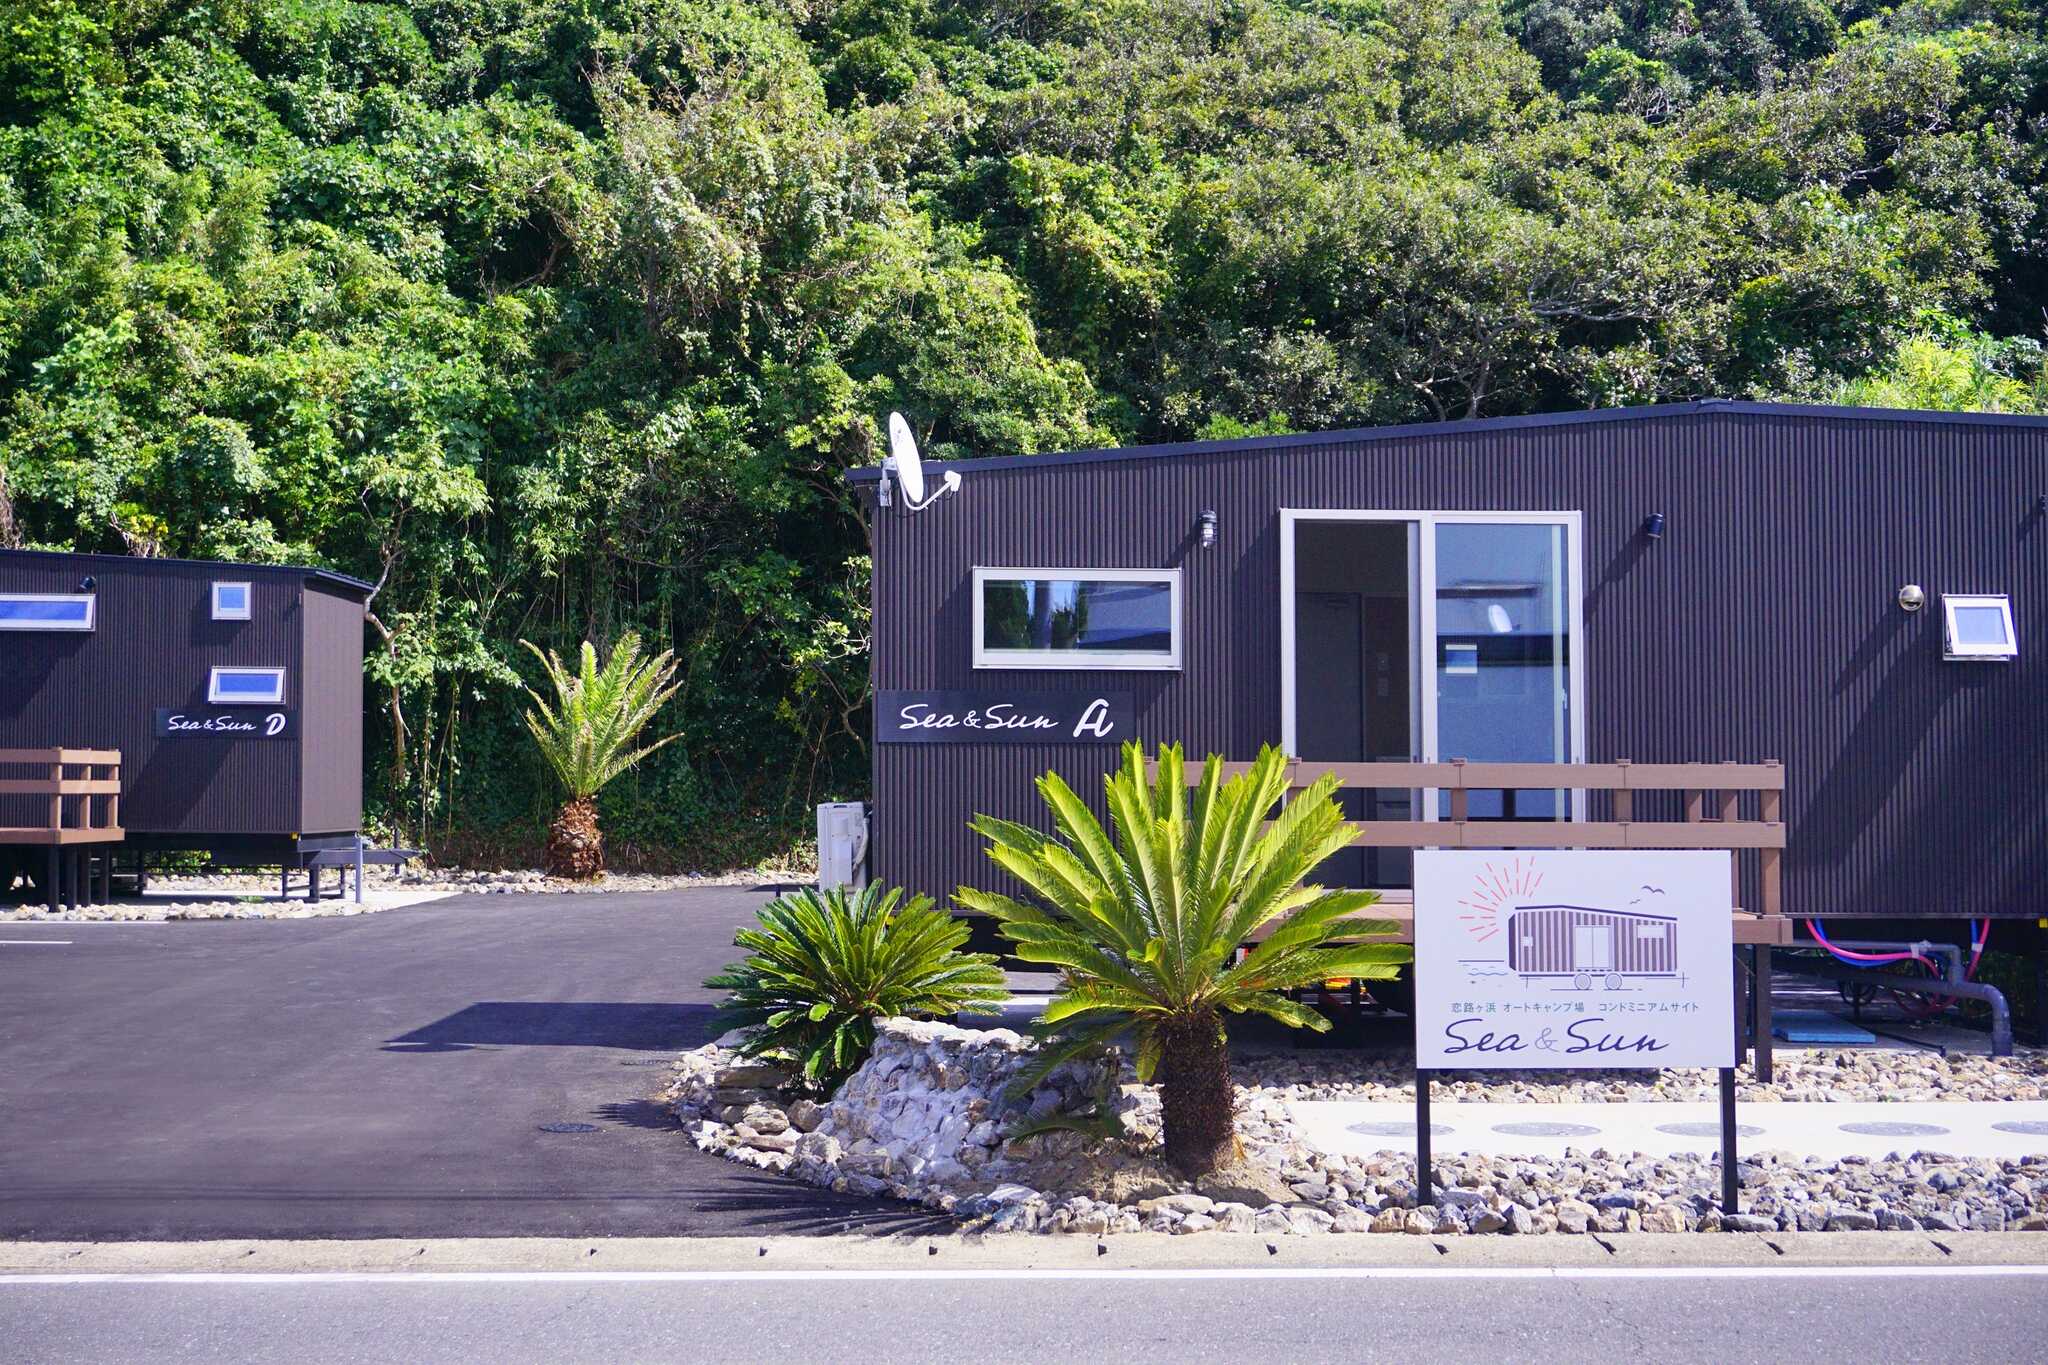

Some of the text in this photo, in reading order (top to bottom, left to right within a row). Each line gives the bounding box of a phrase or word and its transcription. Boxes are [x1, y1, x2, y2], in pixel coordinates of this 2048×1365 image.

[265, 712, 286, 736] D
[899, 698, 1114, 738] Sea & Sun A
[1599, 1001, 1700, 1014] コンドミニアムサイト
[1443, 1018, 1670, 1054] Sea & Sun
